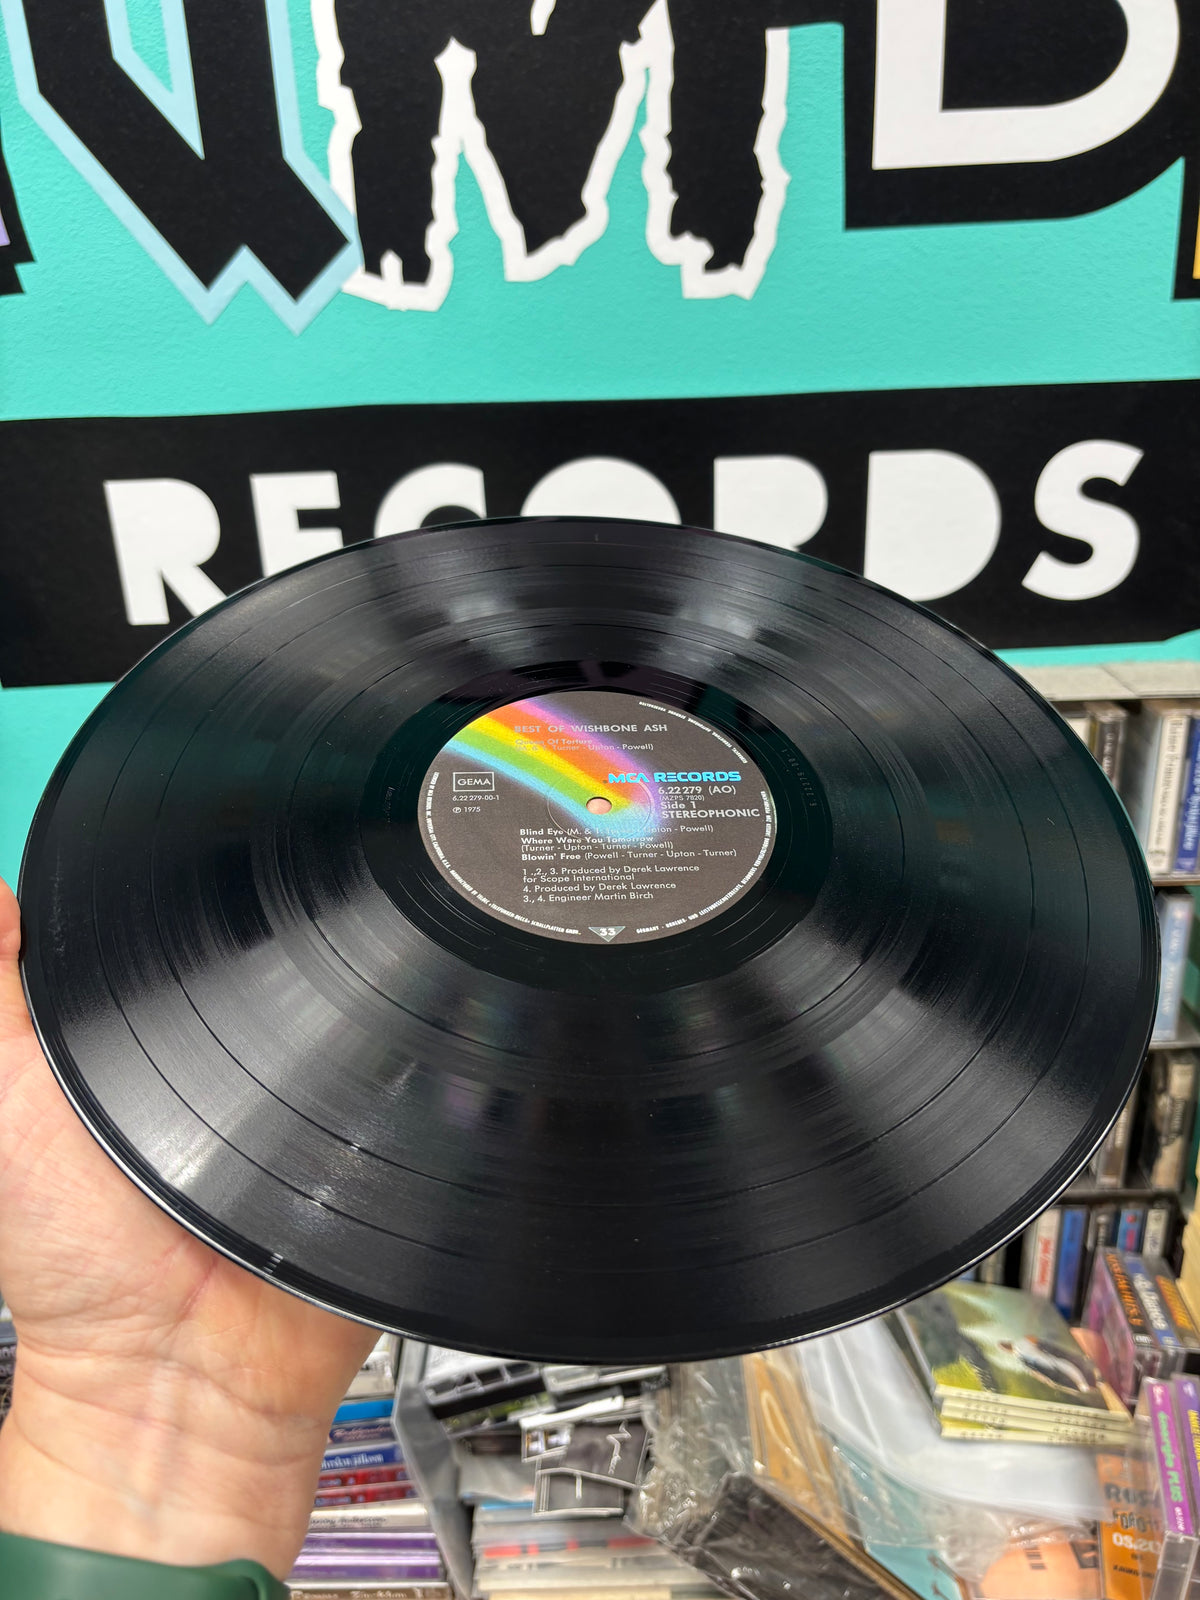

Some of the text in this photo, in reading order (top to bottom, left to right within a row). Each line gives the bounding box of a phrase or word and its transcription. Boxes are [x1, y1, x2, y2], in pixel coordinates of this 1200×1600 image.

[514, 724, 668, 733] BEST OF WISHBONE ASH
[588, 744, 615, 752] Upton
[622, 743, 654, 751] Powell)
[457, 778, 491, 786] GEMA
[608, 771, 742, 784] MCA RECORDS
[708, 785, 737, 795] (AO)
[660, 801, 697, 810] Side 1
[661, 809, 760, 819] STEREOPHONIC
[519, 828, 544, 836] Blind
[547, 828, 564, 836] Eye
[567, 828, 582, 836] (M.
[680, 824, 714, 833] Powell)
[556, 836, 582, 844] Were
[585, 836, 603, 844] You
[521, 844, 555, 853] (Turner
[563, 843, 592, 851] Upton
[640, 841, 674, 850] Powell)
[521, 853, 557, 861] Blowin'
[560, 852, 581, 860] Free
[584, 851, 619, 860] (Powell
[666, 850, 695, 858] Upton
[703, 848, 737, 857] Turner)
[550, 867, 559, 875] 3.
[561, 866, 606, 875] Produced
[608, 866, 621, 874] by
[623, 865, 652, 873] Derek
[523, 873, 635, 883] for Scope International
[523, 882, 677, 893] 4. Produced by Derek Lawrence
[523, 891, 654, 903] 3., 4. Engineer Martin Birch
[600, 927, 616, 937] 33
